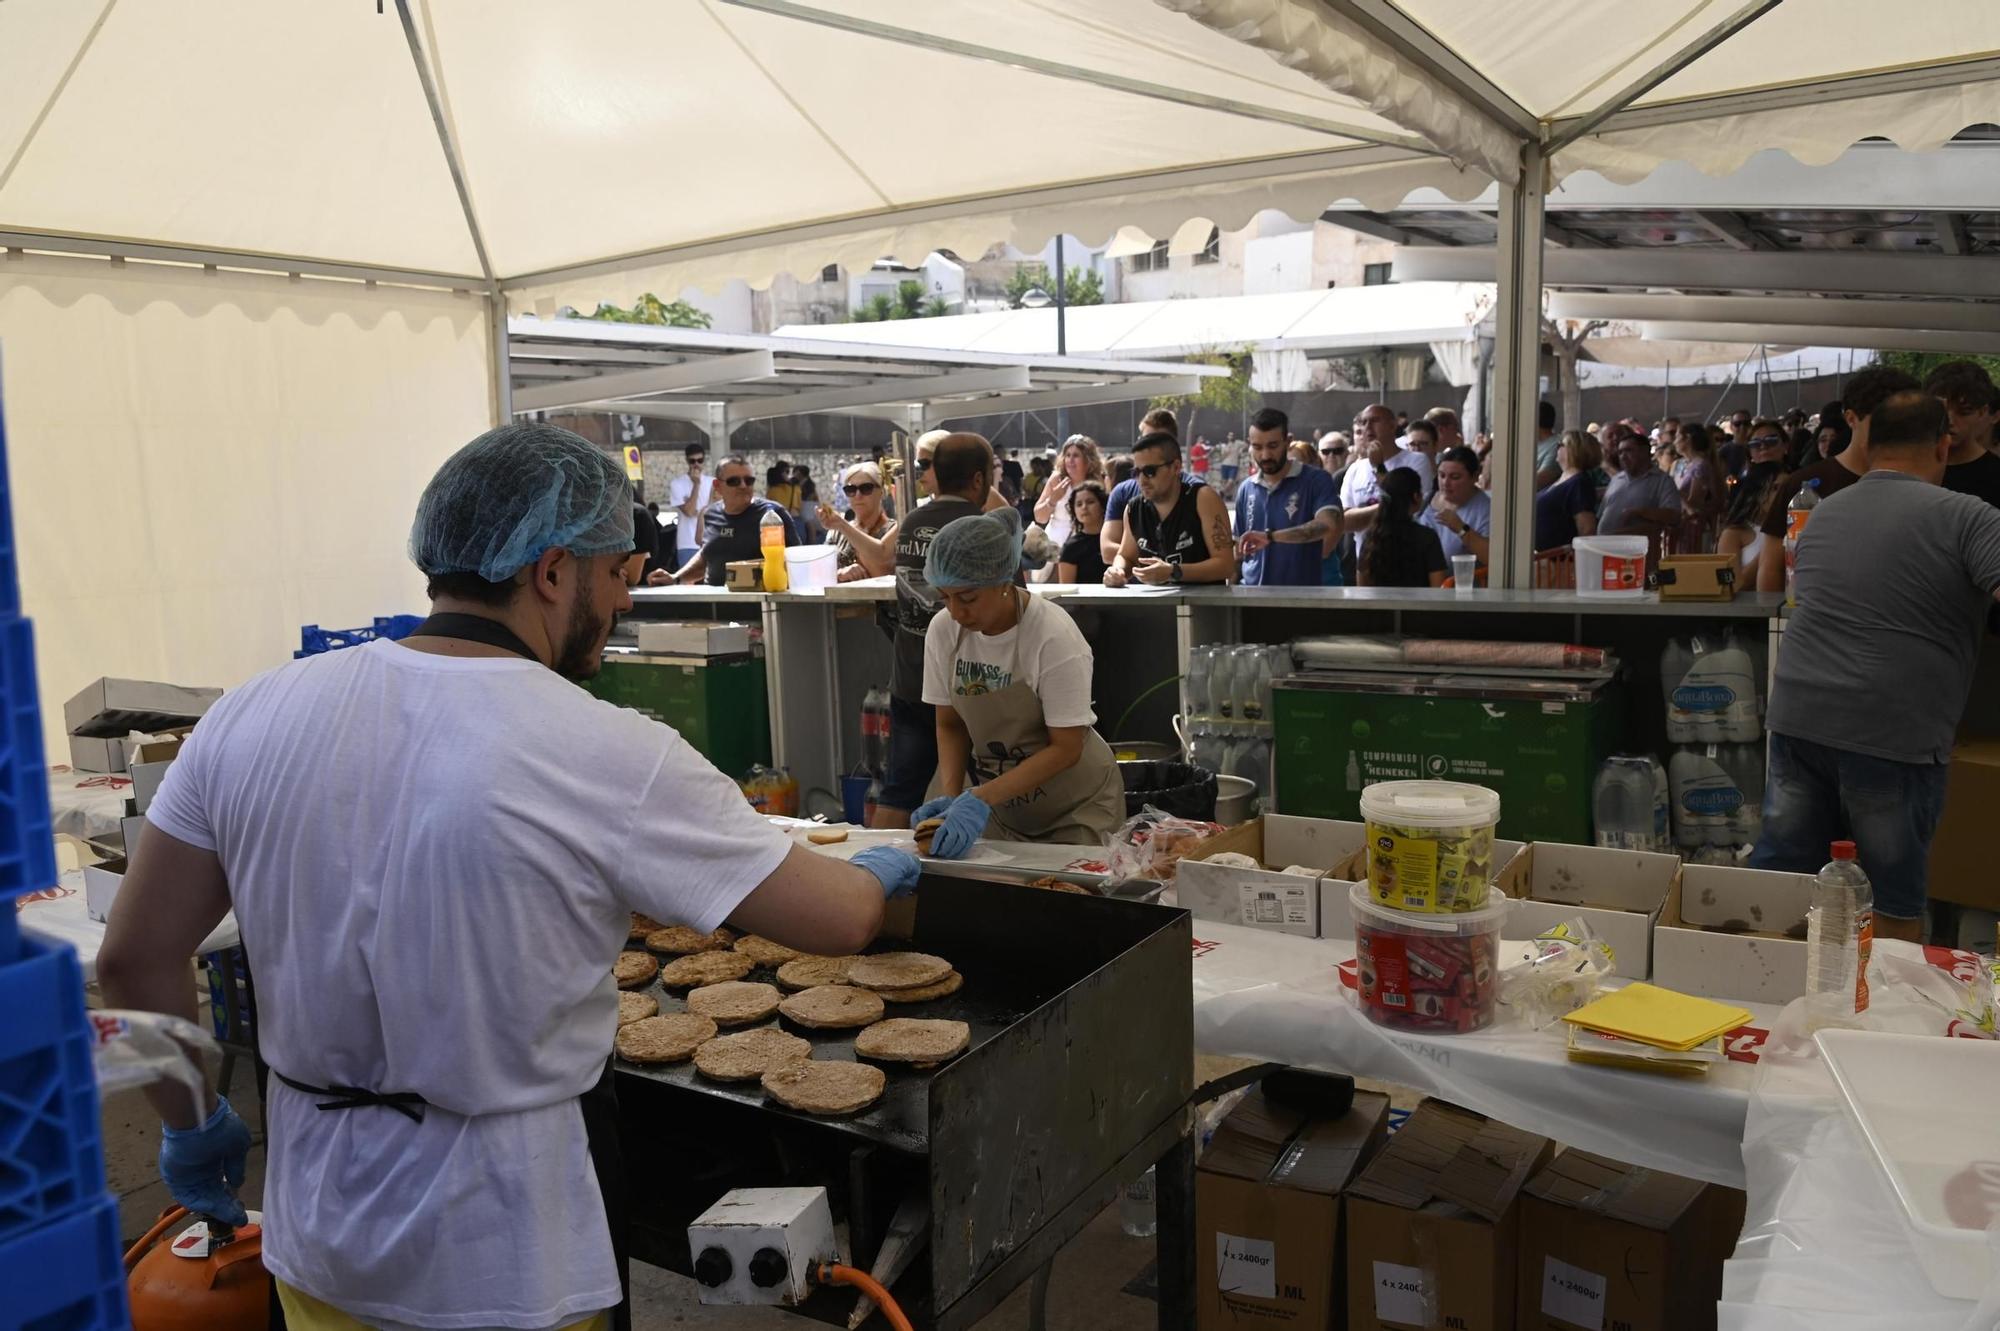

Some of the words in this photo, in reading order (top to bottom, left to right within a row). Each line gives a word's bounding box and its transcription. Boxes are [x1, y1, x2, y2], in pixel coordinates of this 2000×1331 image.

[1238, 1253, 1270, 1266] 2400gr
[1381, 1279, 1388, 1287] 4
[1398, 1282, 1425, 1293] 2400
[1551, 1274, 1557, 1283] 4
[1566, 1281, 1601, 1300] 2400gr
[1445, 1316, 1468, 1330] ML
